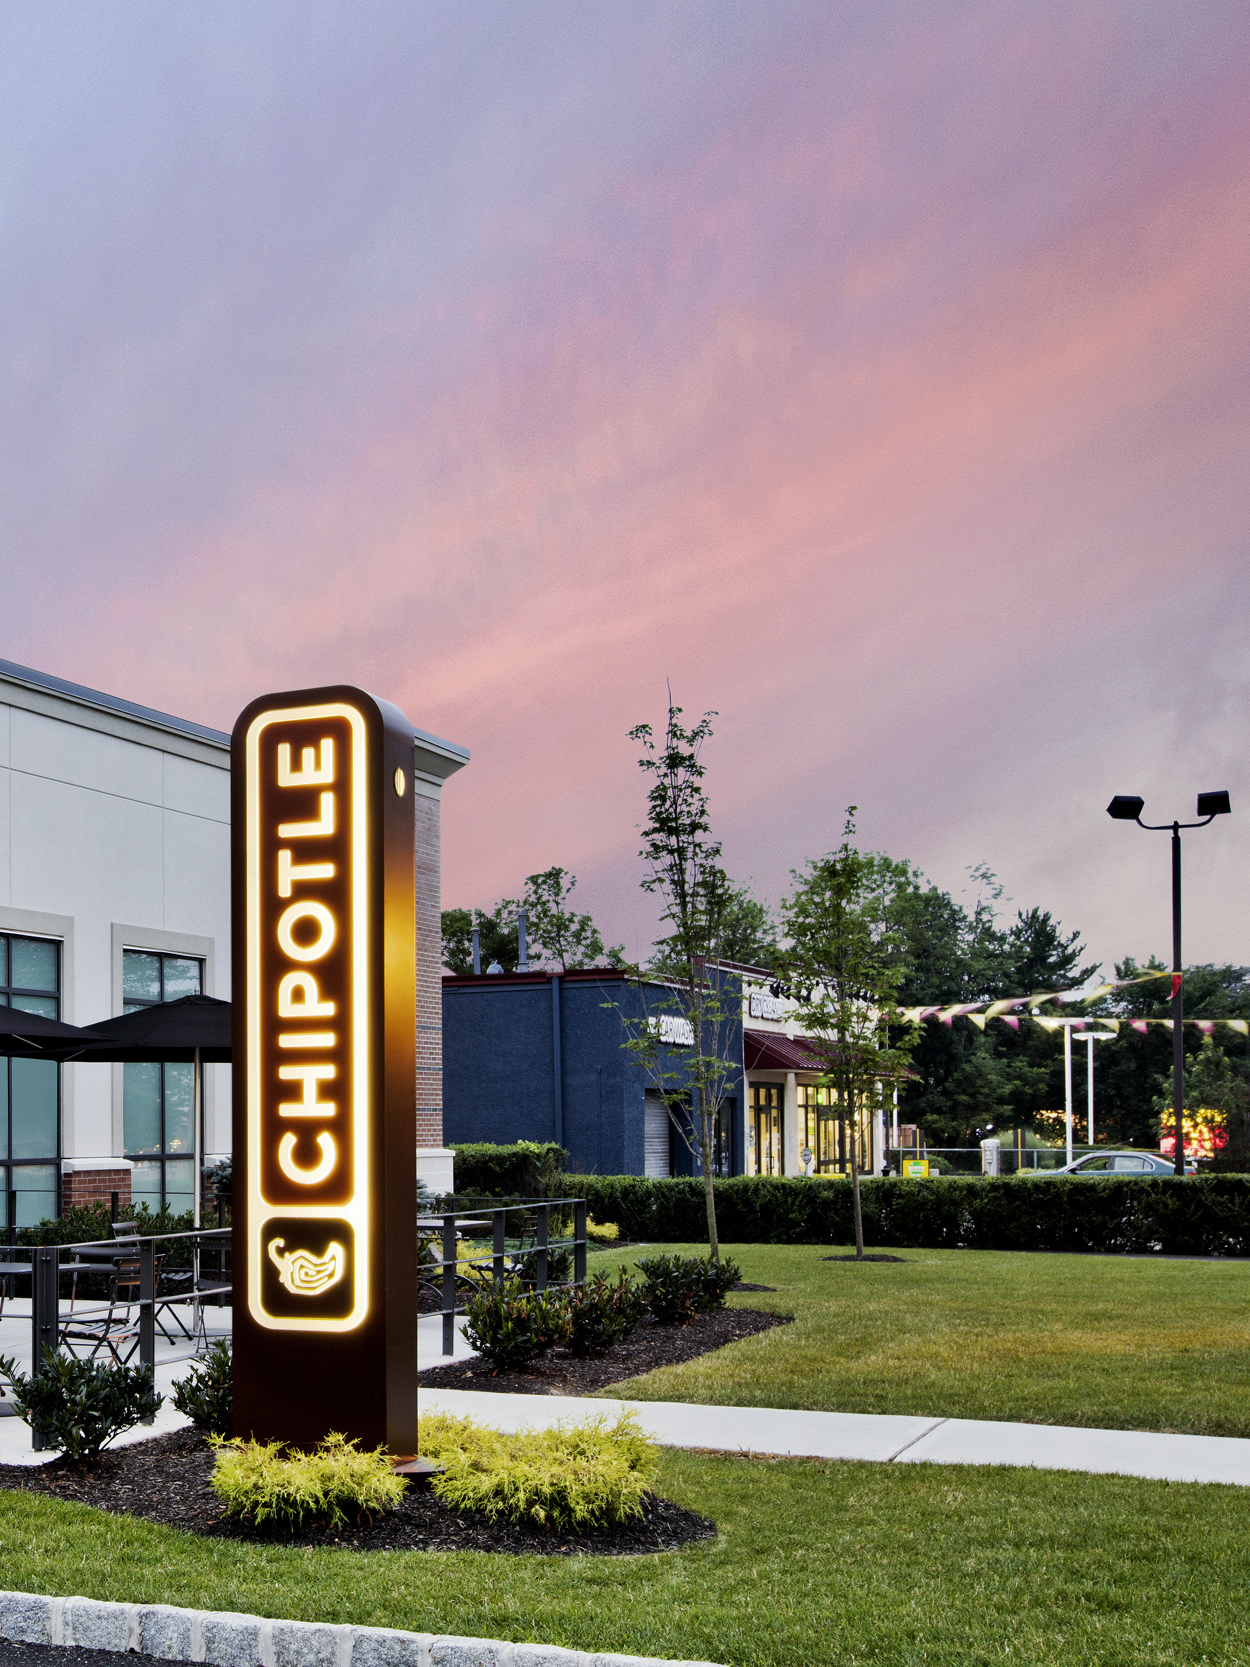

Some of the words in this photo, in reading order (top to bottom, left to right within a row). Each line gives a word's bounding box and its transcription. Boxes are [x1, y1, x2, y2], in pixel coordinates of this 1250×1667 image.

[277, 736, 337, 1186] CHIPOTLE
[751, 993, 763, 1017] DRY
[660, 1014, 675, 1043] CAR
